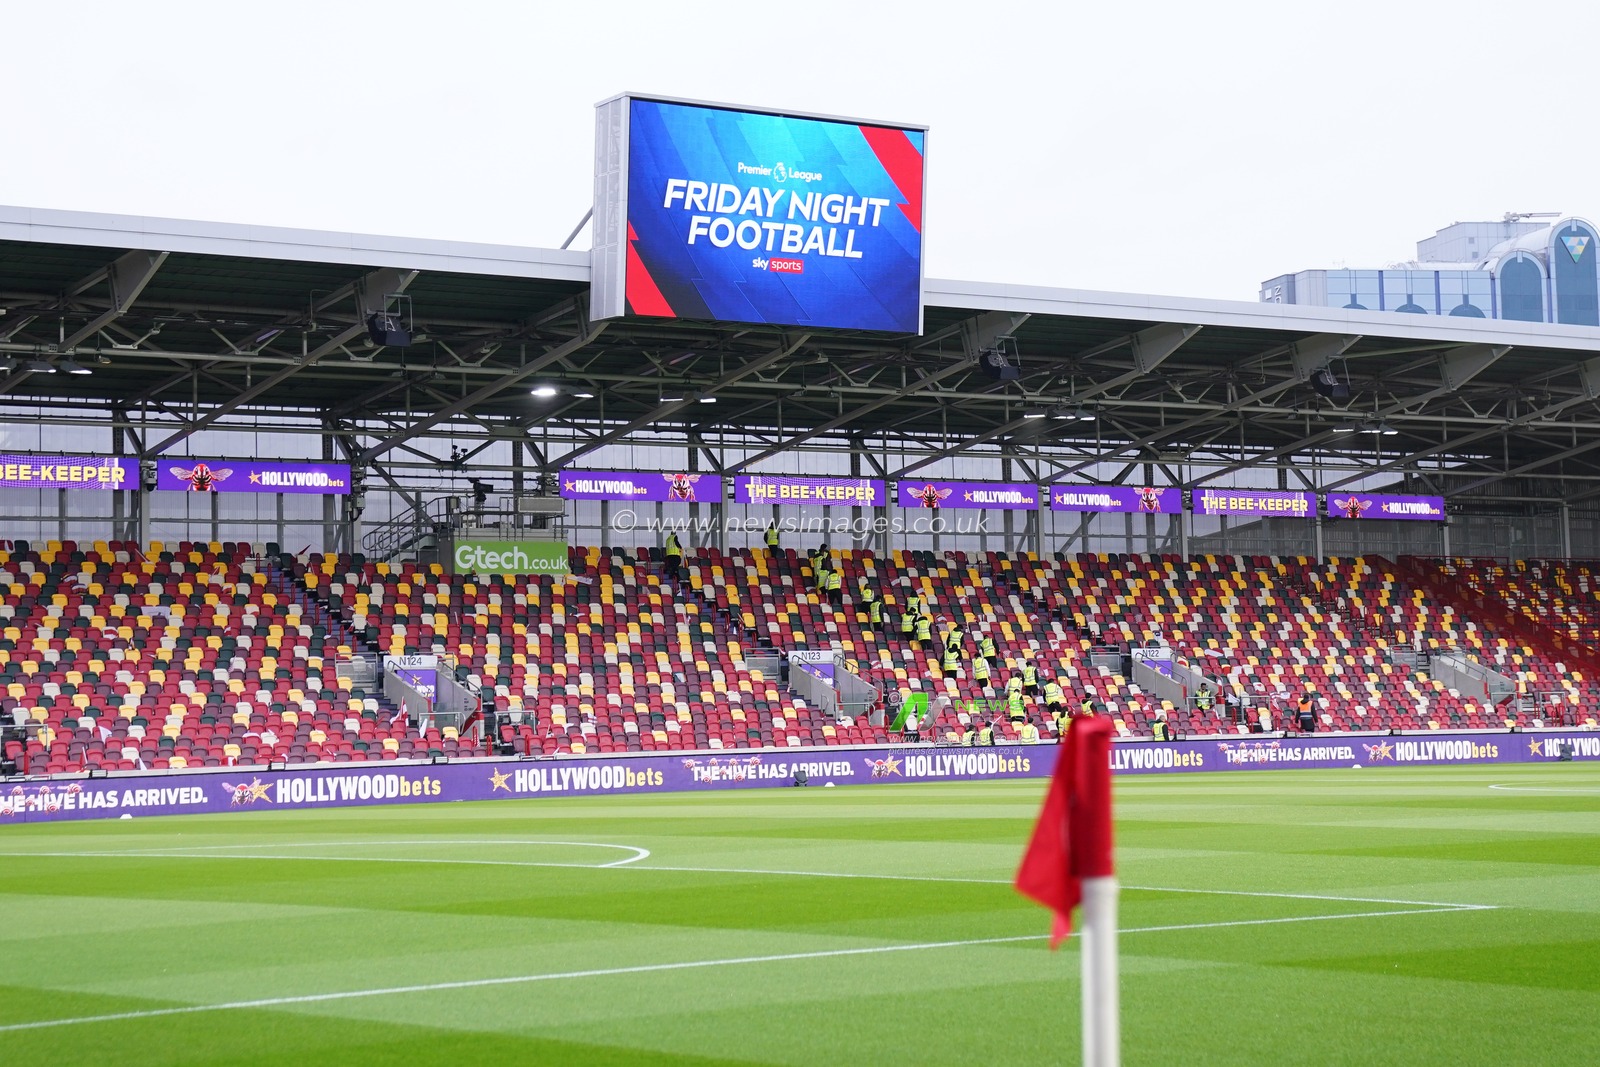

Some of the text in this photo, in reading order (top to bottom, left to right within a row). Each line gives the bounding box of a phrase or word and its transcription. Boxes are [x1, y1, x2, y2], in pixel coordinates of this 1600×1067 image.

[737, 162, 822, 183] Premier League
[663, 178, 890, 227] FRIDAY NIGHT
[687, 215, 863, 259] FOOTBALL
[752, 257, 802, 272] sky sports
[0, 463, 125, 482] EE-KEEPER
[745, 484, 875, 501] THE BEE-KEEPER
[1201, 495, 1309, 512] THE BEE-KEEPER
[454, 544, 568, 571] Gtech.co.uk
[399, 656, 423, 666] N124
[801, 651, 821, 661] N123
[1142, 649, 1160, 658] N122
[1278, 748, 1302, 761] HAS
[1303, 747, 1355, 760] ARRIVED.
[1395, 740, 1498, 761] HOLLYWOODbets
[692, 765, 720, 781] THE
[758, 763, 787, 778] HAS
[905, 753, 1031, 778] HOLLYWOODbets
[276, 774, 441, 804] HOLLYWOODbets
[515, 766, 664, 793] HOLLYWOODbets
[0, 795, 25, 813] HE
[78, 790, 119, 809] HAS
[121, 786, 208, 808] ARRIVED.
